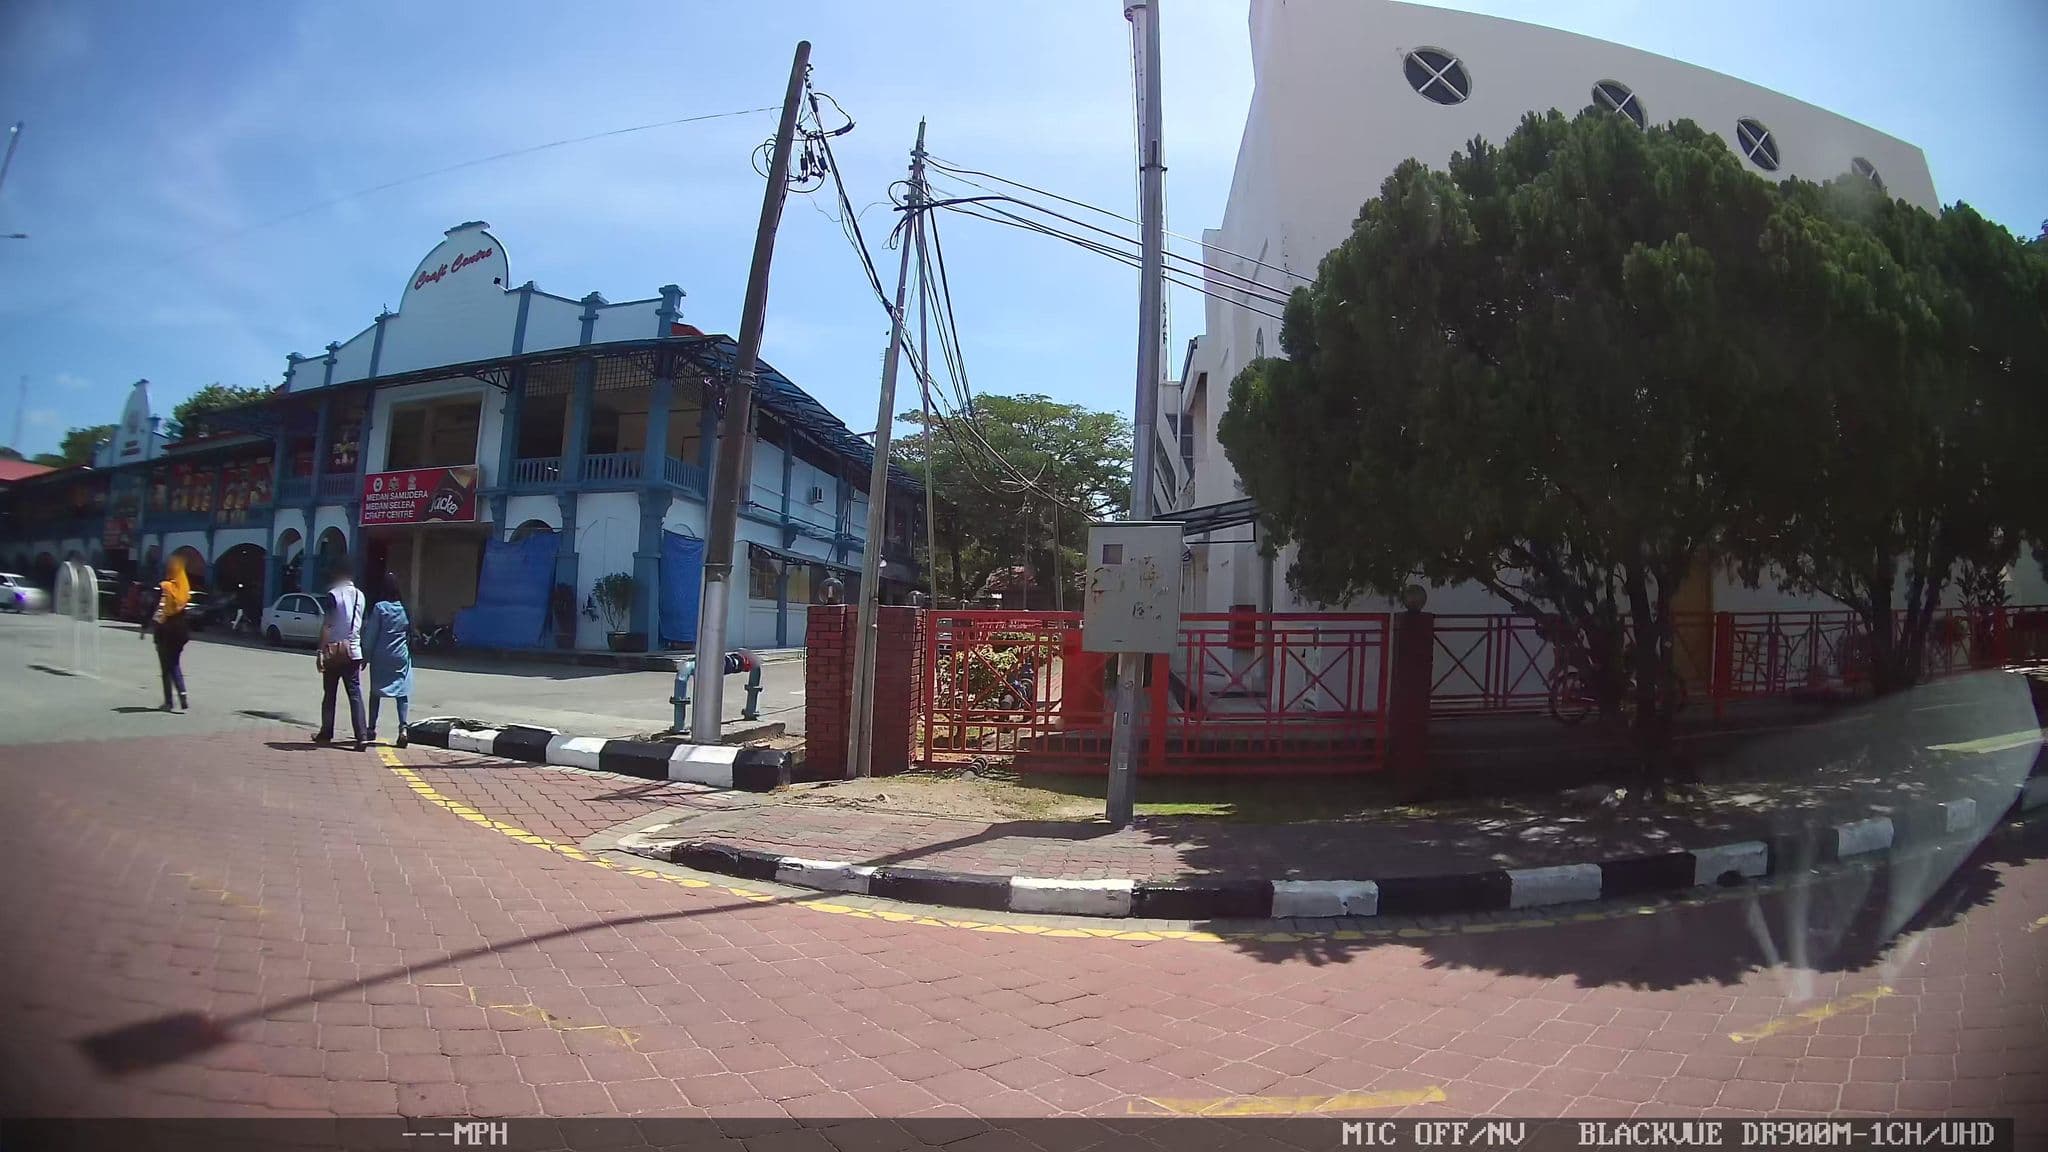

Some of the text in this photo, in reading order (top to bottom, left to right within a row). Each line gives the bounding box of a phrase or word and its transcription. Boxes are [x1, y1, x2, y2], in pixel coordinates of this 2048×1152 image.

[415, 248, 493, 290] Craft Centre
[366, 490, 428, 502] MEDAN SAMUDERA
[365, 500, 415, 510] MEDAN SELERA
[364, 510, 414, 520] CRAFT CENTRE
